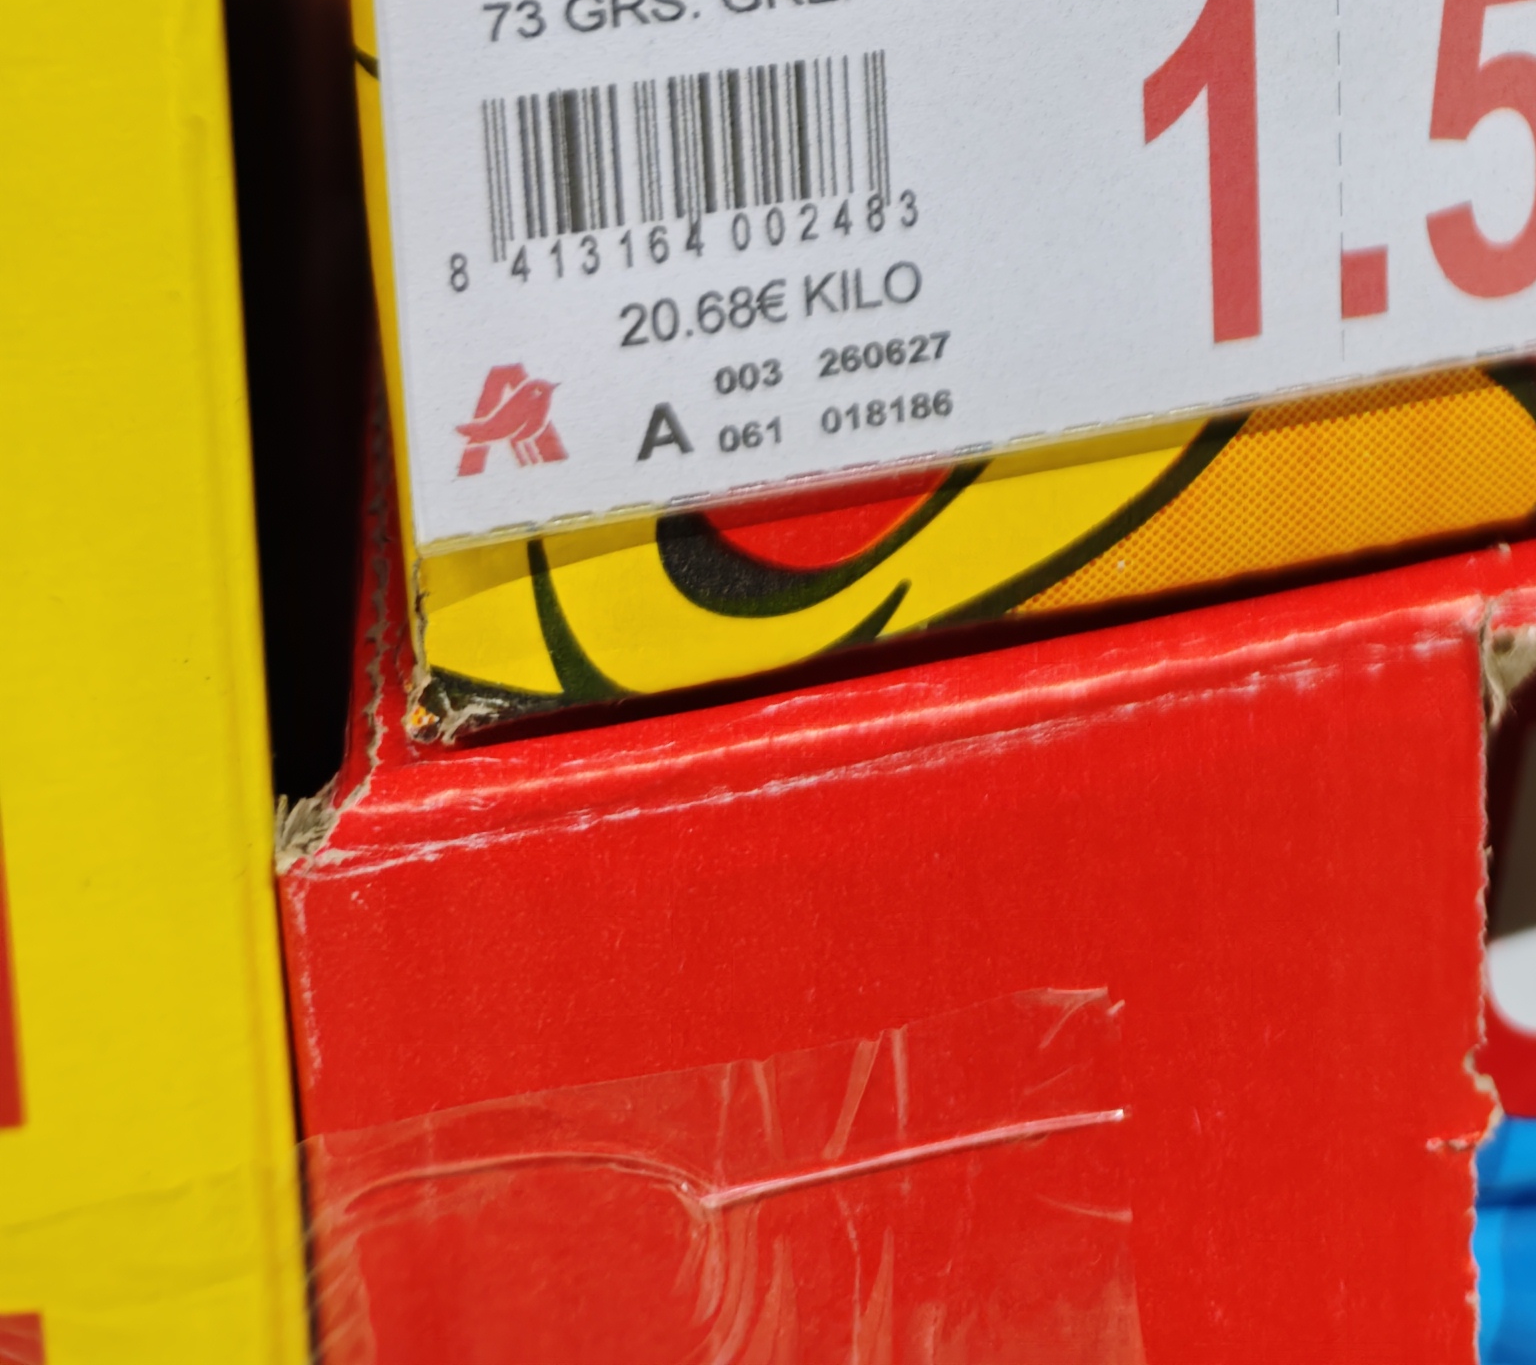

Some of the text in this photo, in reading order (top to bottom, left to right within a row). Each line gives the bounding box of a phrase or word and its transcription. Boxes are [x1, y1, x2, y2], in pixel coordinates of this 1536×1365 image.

[483, 0, 546, 42] 73
[620, 262, 921, 347] 20.68€ KILO
[714, 331, 950, 395] 003 260627
[637, 403, 693, 461] A
[718, 390, 953, 453] 061 018186
